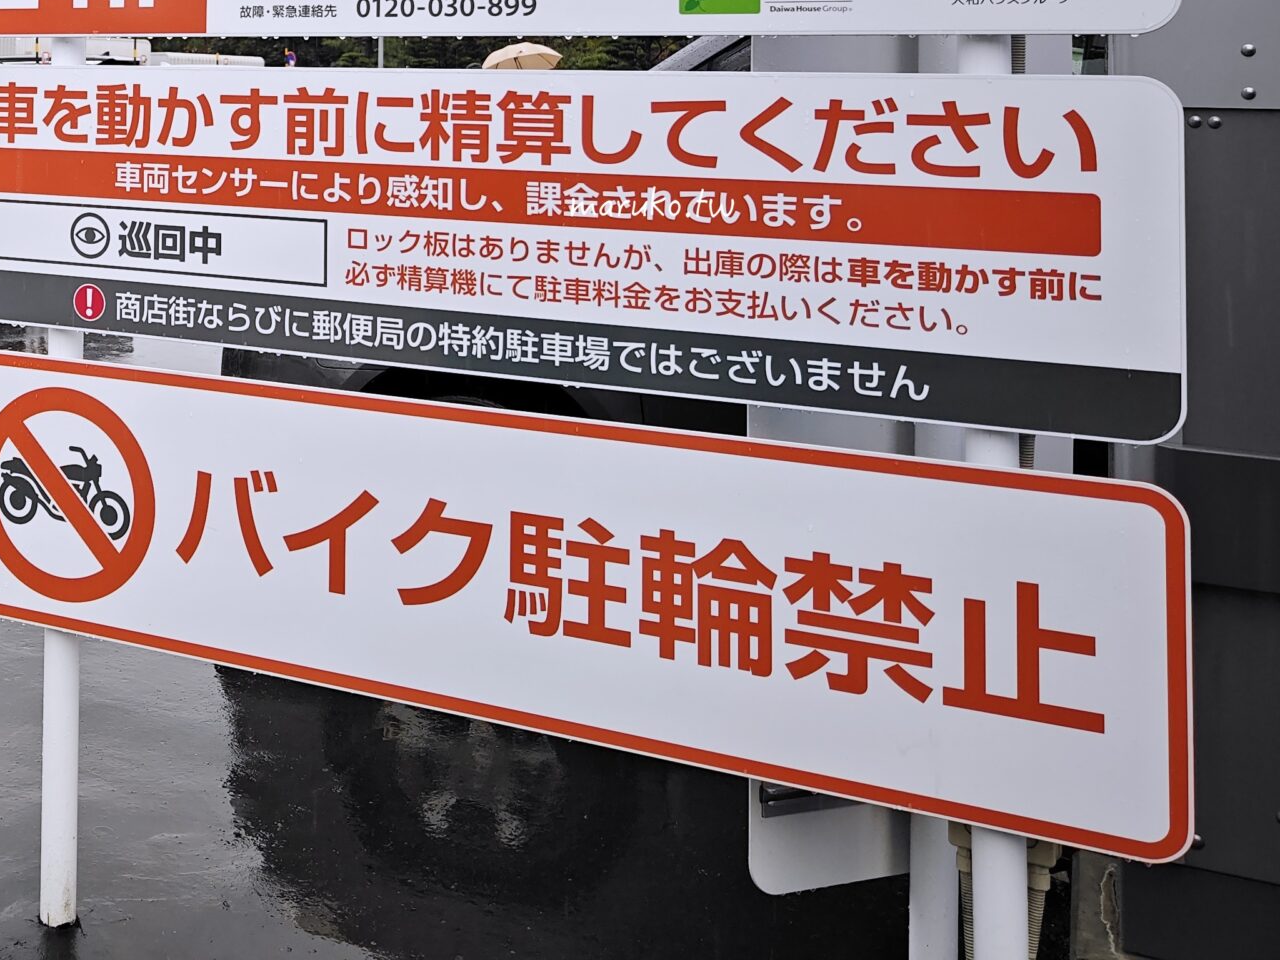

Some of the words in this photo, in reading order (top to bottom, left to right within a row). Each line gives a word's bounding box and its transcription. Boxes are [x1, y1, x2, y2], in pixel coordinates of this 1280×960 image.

[239, 4, 337, 19] 故障・緊急連絡先
[115, 161, 863, 232] 車両センサーにより感知し、課金されています。
[118, 220, 222, 264] 巡回中
[347, 227, 1102, 303] ロック板はありませんが、出庫の際は車を動かす前に
[345, 261, 969, 335] 必ず精算機にて駐車料金をお支払いください。
[115, 291, 930, 402] 商店街ならびに郵便局の特約駐車場ではございません
[176, 469, 1107, 735] バイク駐輪禁止
